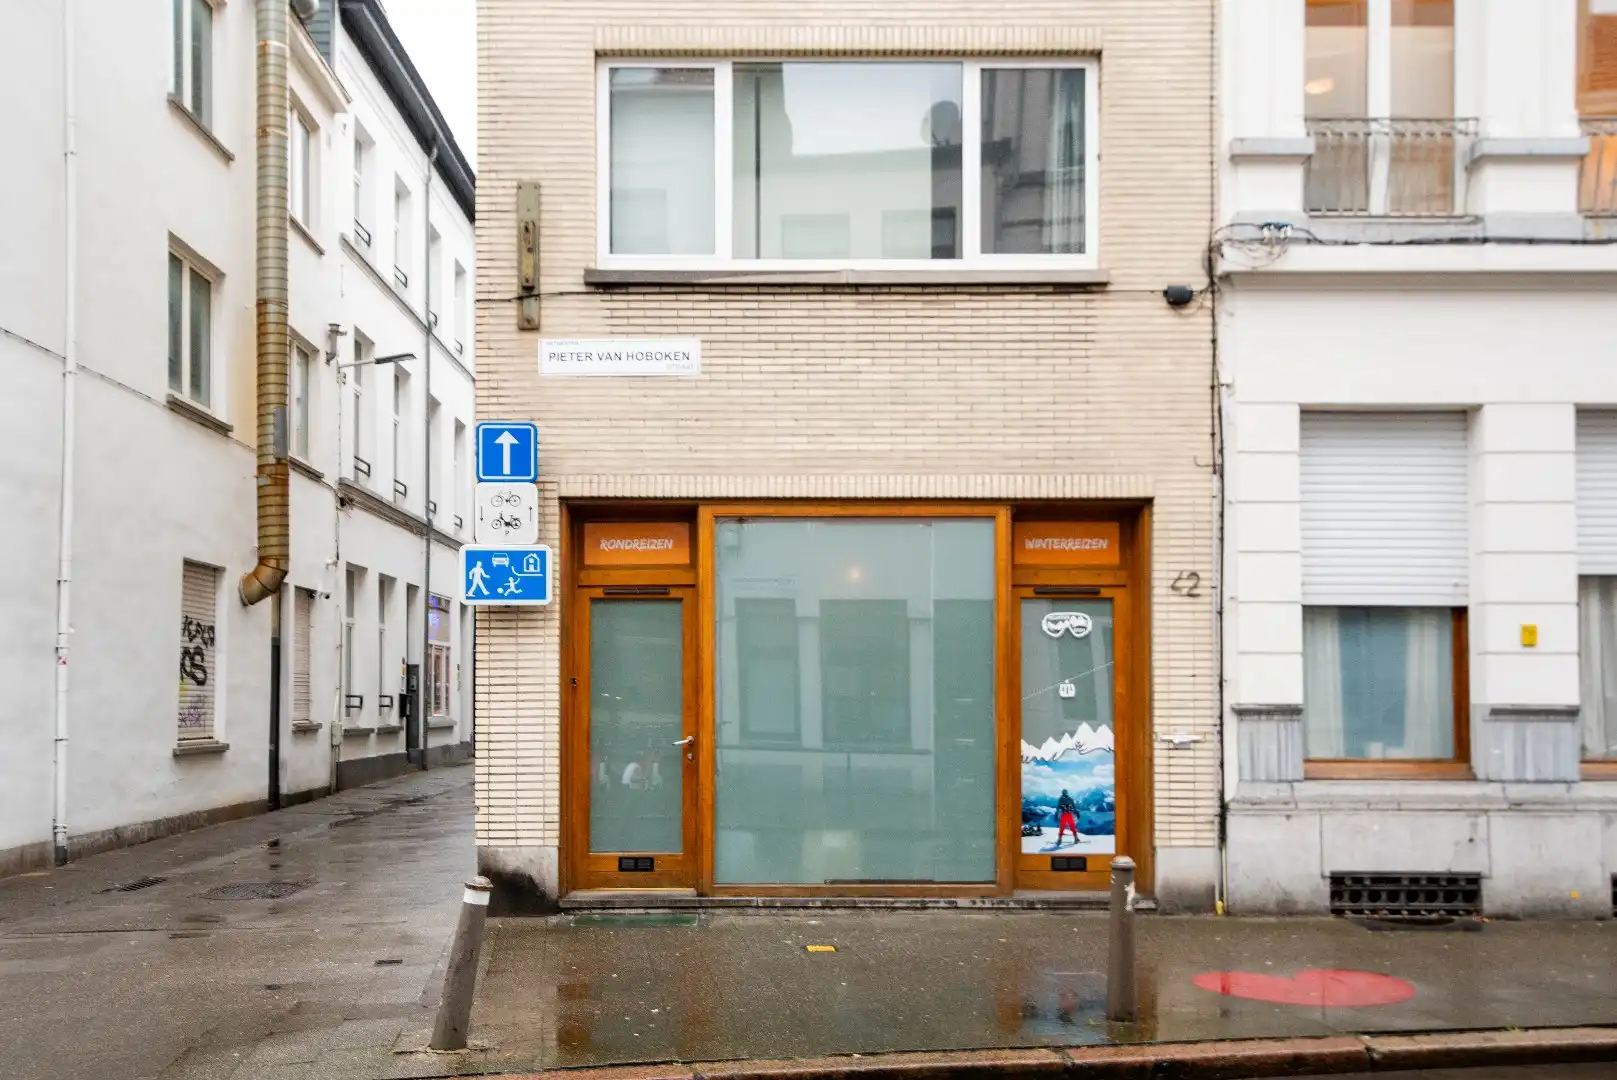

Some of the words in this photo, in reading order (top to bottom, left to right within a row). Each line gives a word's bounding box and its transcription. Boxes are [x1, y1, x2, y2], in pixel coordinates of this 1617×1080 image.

[548, 351, 593, 362] PIETER
[597, 351, 622, 362] VAN
[626, 351, 690, 362] HOBOKEN
[600, 538, 673, 551] RONDREIZEN
[1025, 538, 1109, 551] WINTERREIZEN
